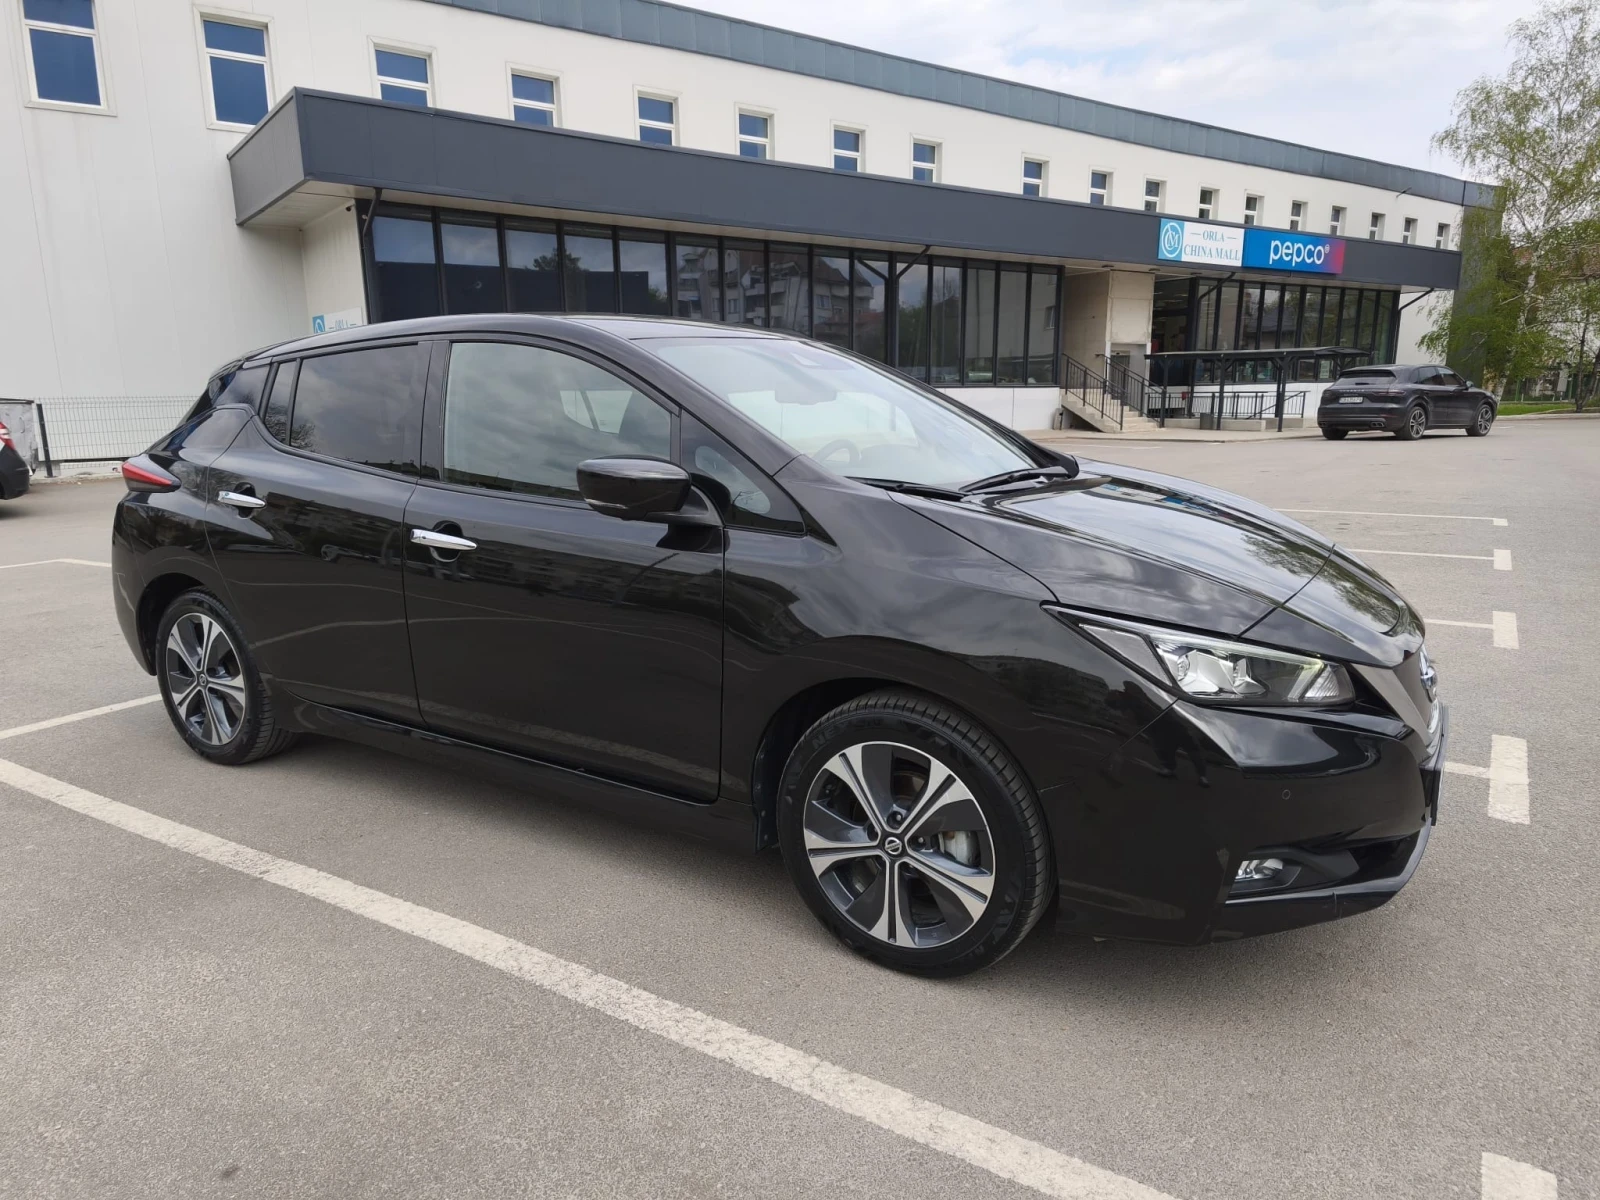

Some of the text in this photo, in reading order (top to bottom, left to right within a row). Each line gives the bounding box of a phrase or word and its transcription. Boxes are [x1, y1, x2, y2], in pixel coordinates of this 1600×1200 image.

[1202, 229, 1225, 242] ORLA
[1184, 244, 1240, 261] CHINA MALL
[1269, 239, 1325, 267] pepco
